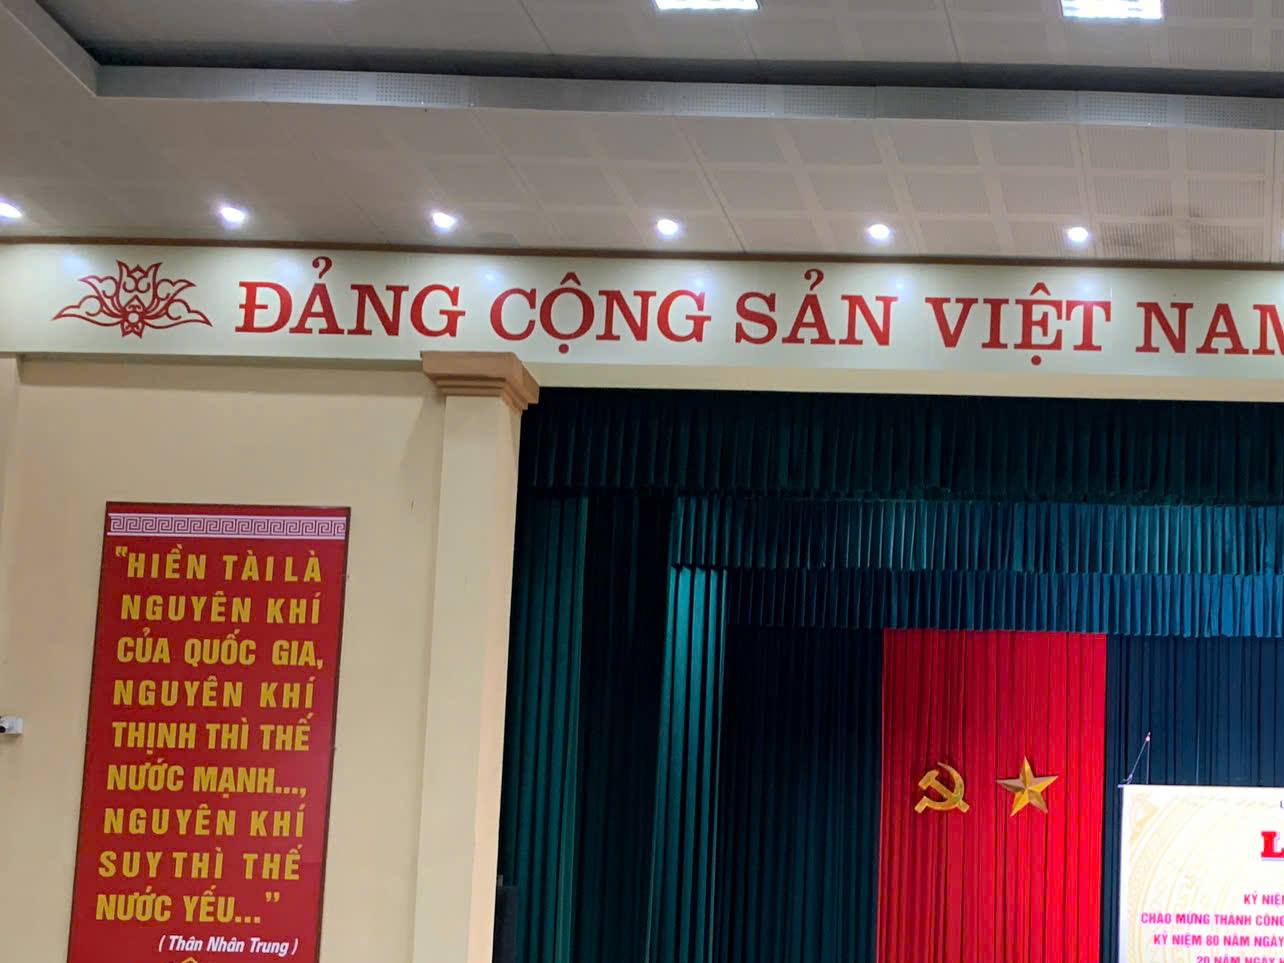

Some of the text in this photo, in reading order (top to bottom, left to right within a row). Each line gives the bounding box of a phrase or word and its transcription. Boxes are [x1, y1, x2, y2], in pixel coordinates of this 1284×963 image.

[235, 256, 466, 338] ĐẢNG
[490, 273, 712, 352] CỘNG
[736, 270, 896, 346] SẢN
[926, 282, 1112, 362] VIỆT
[223, 550, 274, 581] TÀI
[285, 550, 321, 582] LÀ
[121, 591, 320, 624] NGUYÊN KHÍ
[118, 627, 323, 669] CỦA QUỐC GIA,
[114, 676, 315, 708] NGUYÊN KHÍ
[112, 712, 313, 754] THỊNH THÌ THẾ
[107, 758, 184, 791] NƯỚC
[104, 803, 306, 838] NGUYÊN KHÍ
[99, 844, 302, 880] SUY THÌ THẾ
[96, 886, 172, 922] NƯỚC
[206, 936, 245, 952] Nhân
